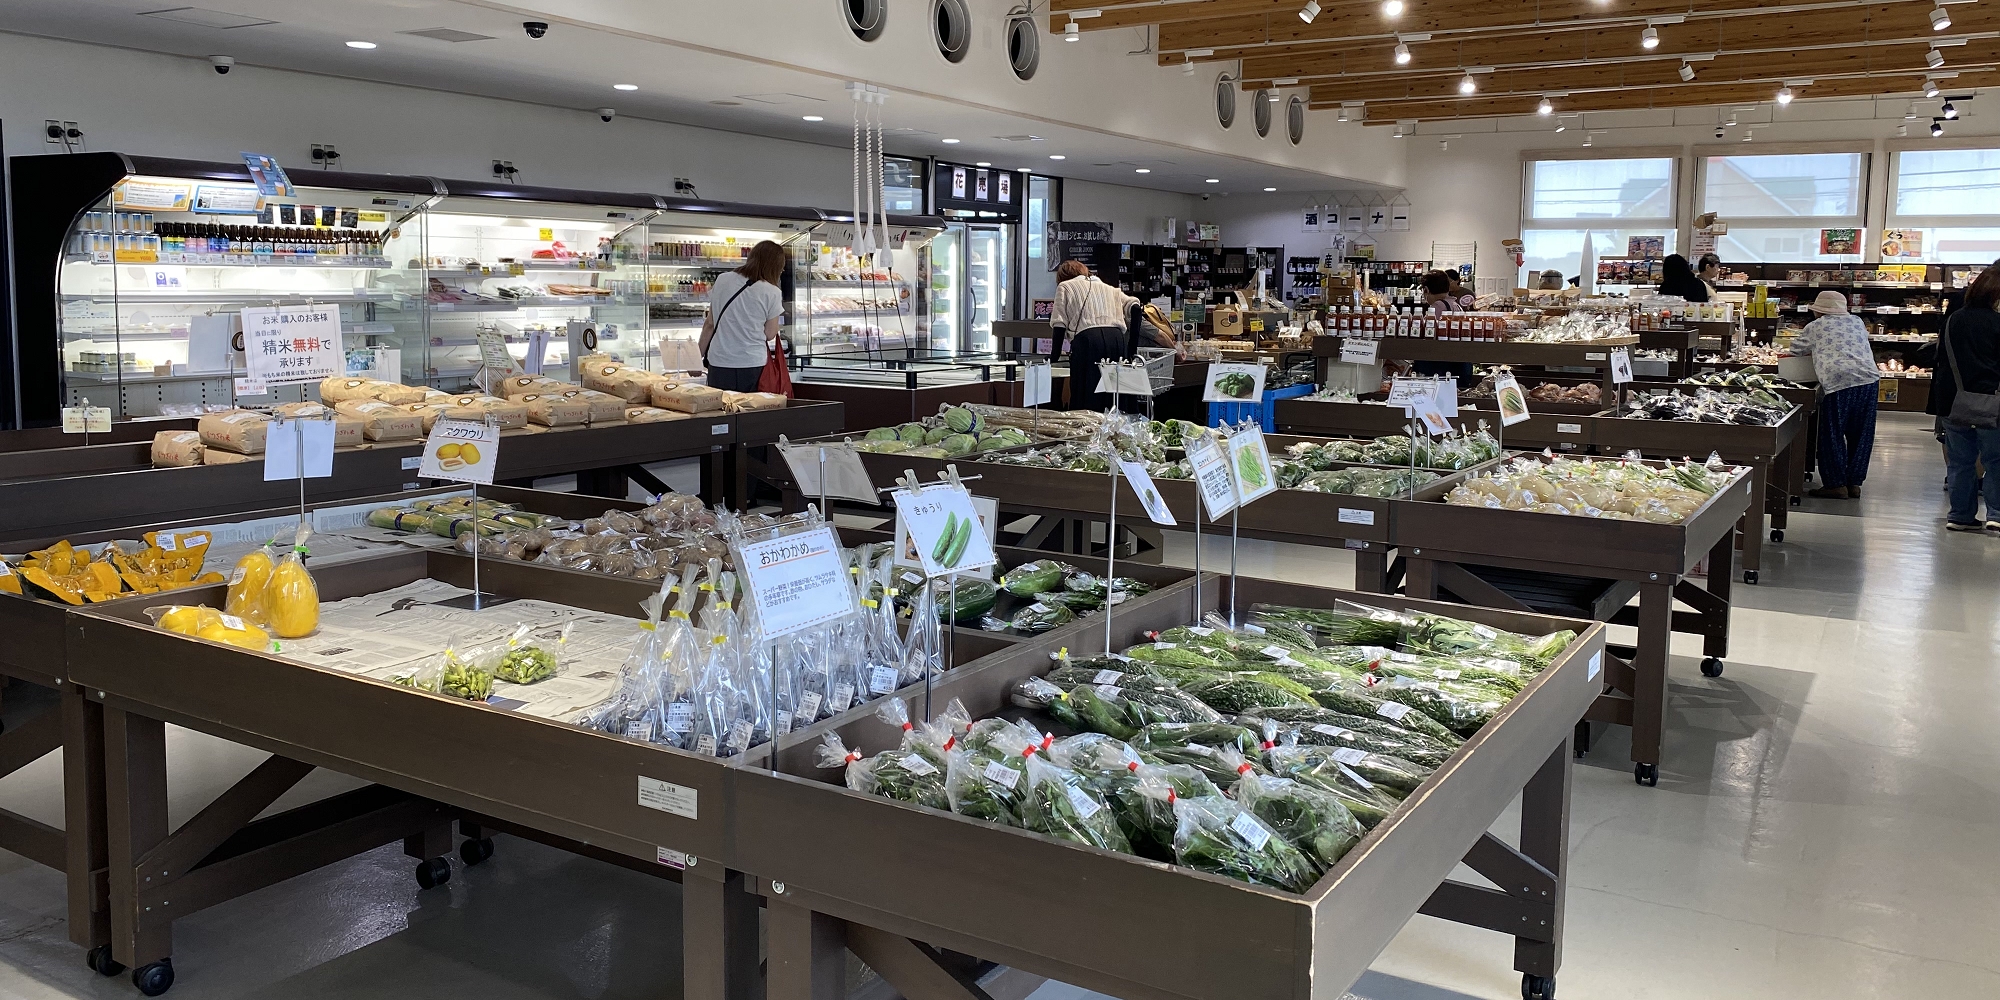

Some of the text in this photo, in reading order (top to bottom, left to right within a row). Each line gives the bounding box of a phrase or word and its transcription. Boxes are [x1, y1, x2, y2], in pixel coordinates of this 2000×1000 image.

[1305, 211, 1406, 225] 酒コーナー
[262, 336, 331, 356] 精米無料で
[279, 355, 313, 369] 承ります
[913, 501, 943, 517] きゅうり
[759, 541, 810, 565] おかわかめ
